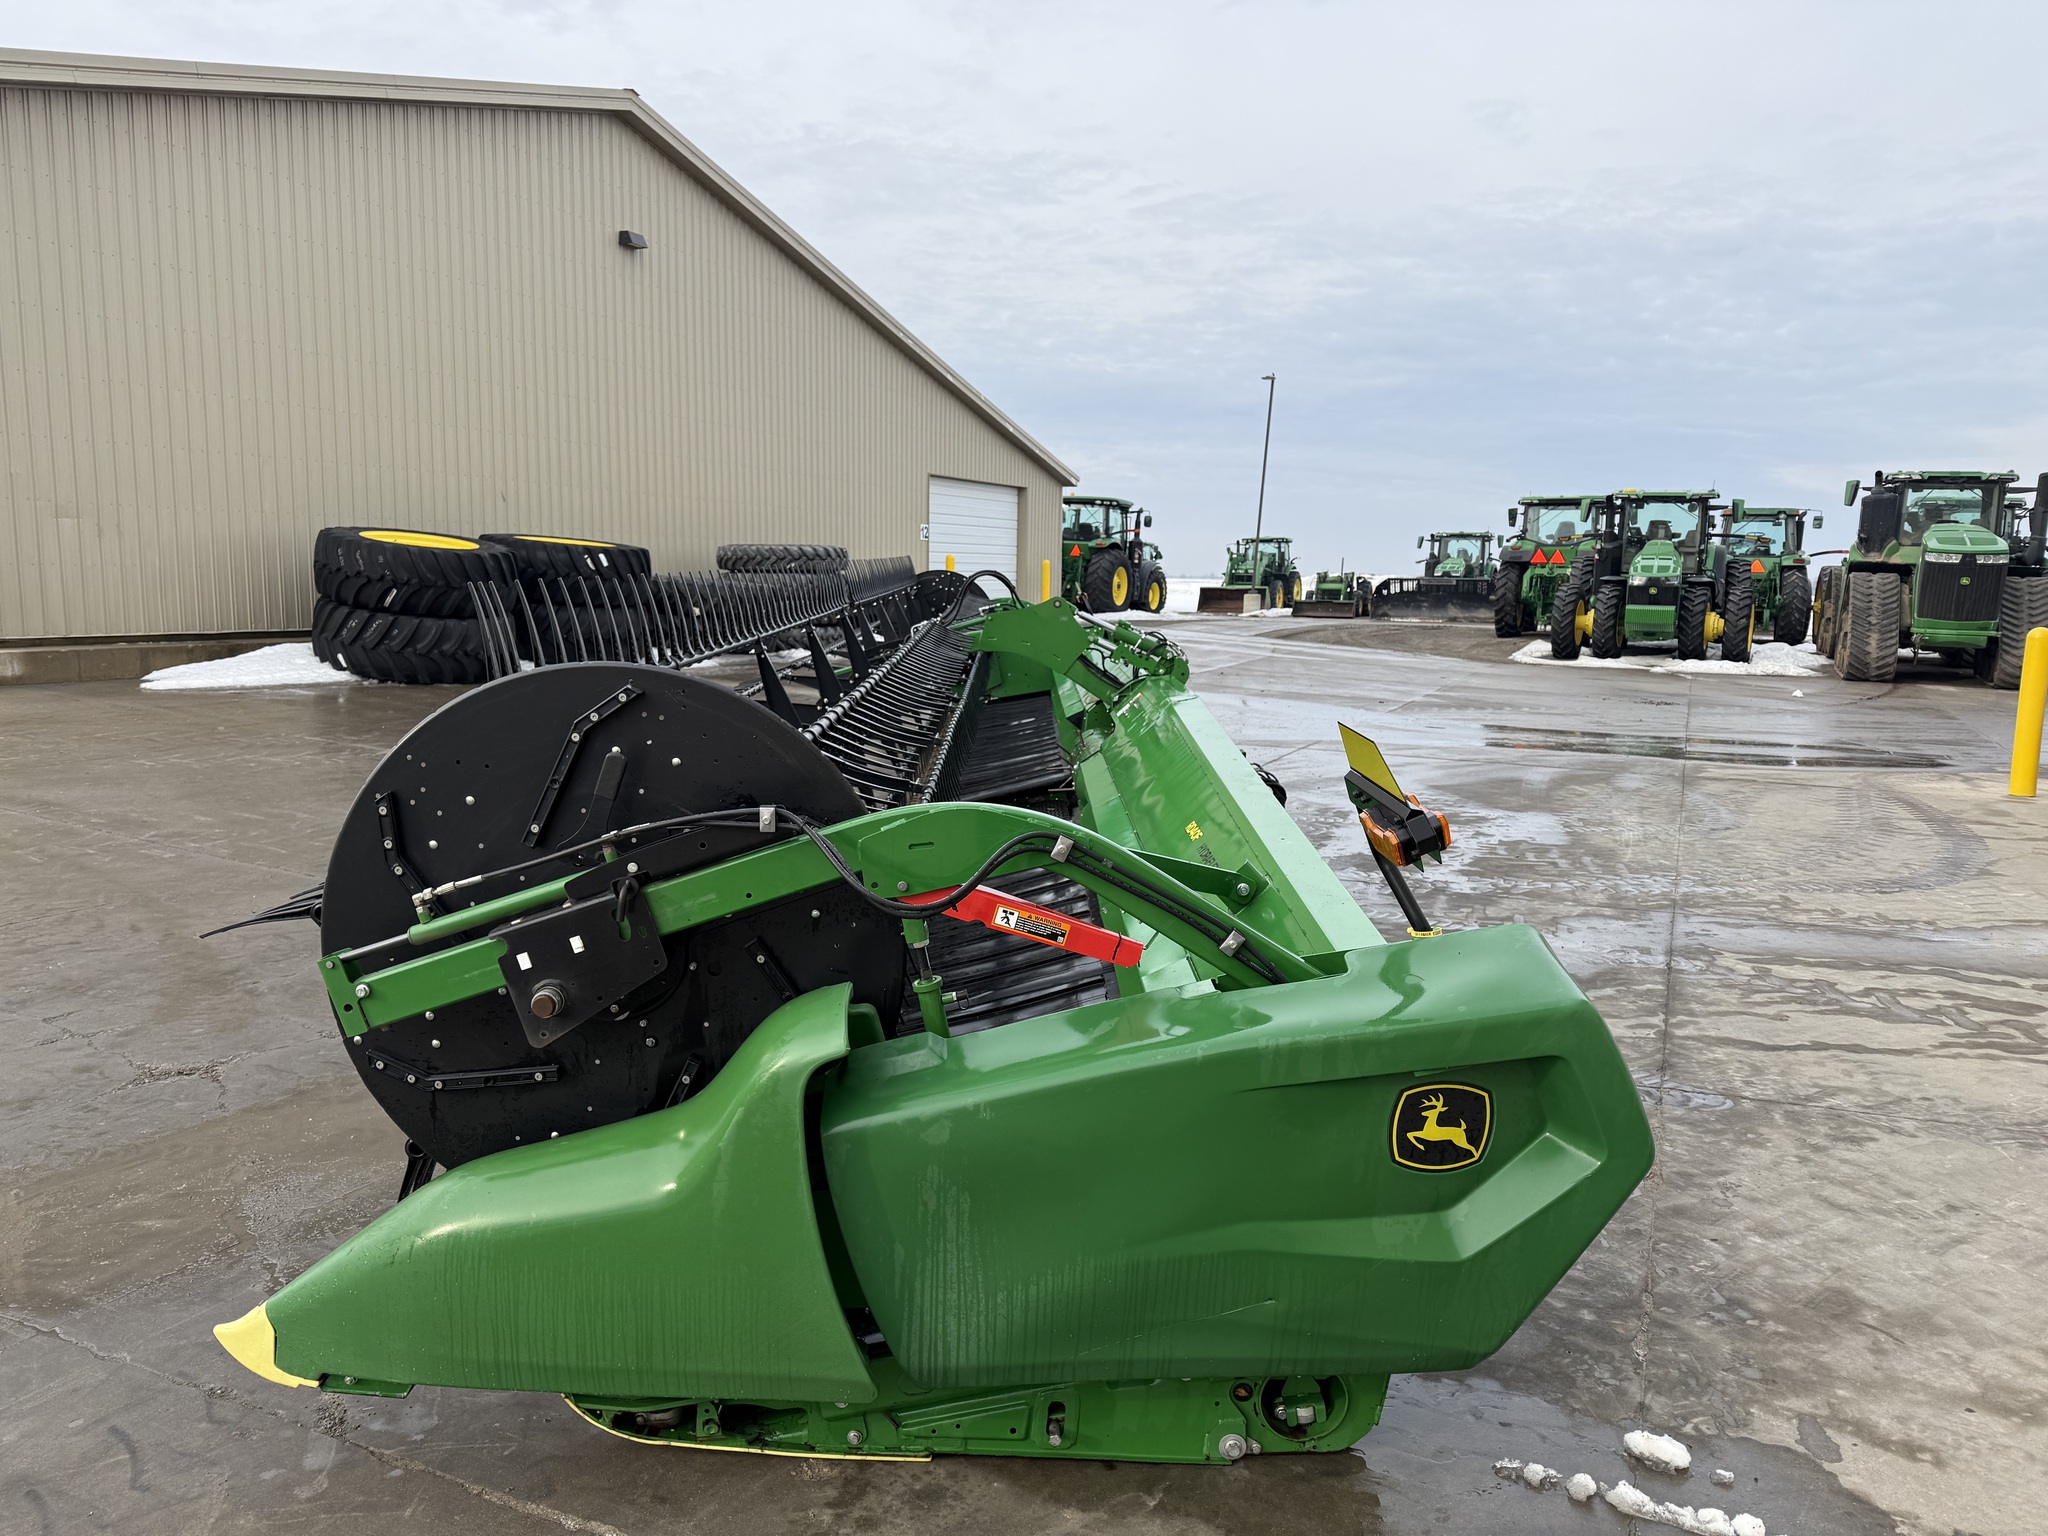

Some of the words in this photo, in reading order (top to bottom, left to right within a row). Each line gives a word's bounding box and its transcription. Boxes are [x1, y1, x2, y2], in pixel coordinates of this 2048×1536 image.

[921, 526, 929, 539] 12
[1197, 842, 1220, 868] HYDRAFLE
[1034, 915, 1062, 928] WARNING
